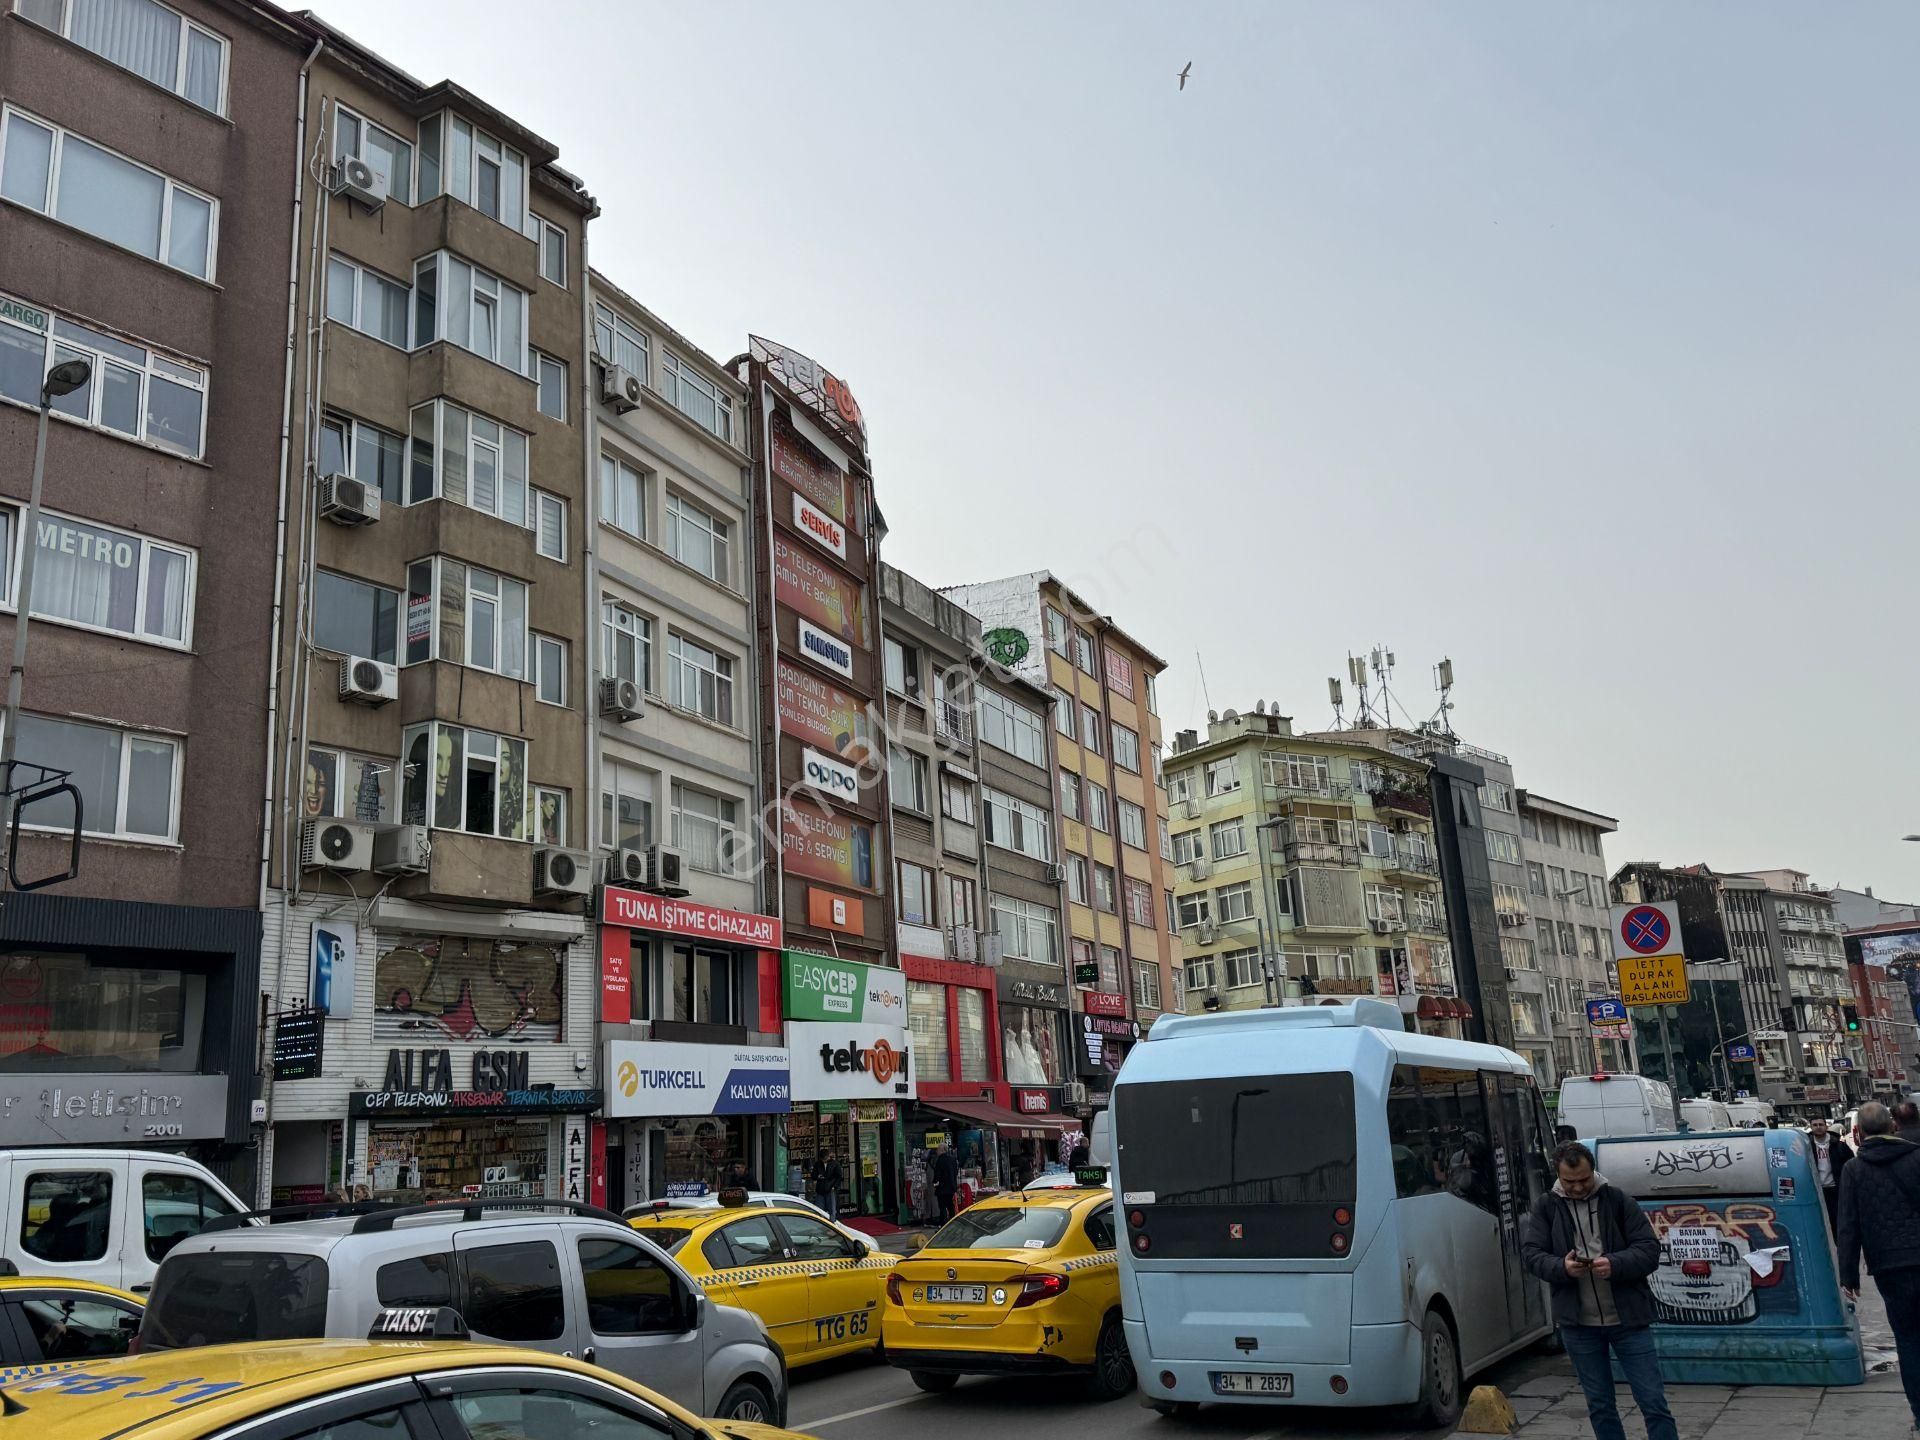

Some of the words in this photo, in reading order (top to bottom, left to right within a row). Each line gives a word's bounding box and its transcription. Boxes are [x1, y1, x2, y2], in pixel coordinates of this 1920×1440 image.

[0, 300, 44, 328] ARGO
[801, 507, 841, 548] SERVİS
[35, 520, 133, 569] METRO
[775, 541, 788, 559] EP
[790, 550, 836, 590] TELEFONU
[800, 578, 812, 597] VE
[804, 630, 849, 669] SAMSUNG
[780, 704, 806, 726] RÜNLER
[807, 761, 856, 792] oppo
[798, 812, 846, 841] TELEFONU
[616, 897, 658, 922] TUNA
[661, 900, 705, 929] İŞİTME
[707, 910, 773, 941] CİHAZLARI
[793, 963, 858, 995] EASYCEP
[1630, 968, 1674, 980] DURAK
[1633, 980, 1674, 991] ALANI
[827, 999, 848, 1009] EXPRESS
[1624, 989, 1686, 1003] BAŞLANGICI
[1093, 1018, 1111, 1033] LOTUS
[382, 1048, 453, 1091] ALFA
[472, 1050, 529, 1091] GSM
[640, 1069, 706, 1089] TURKCELL
[365, 1092, 391, 1107] CEP
[392, 1091, 448, 1107] TELEFONU
[453, 1092, 504, 1107] AKSESUAR
[730, 1084, 767, 1099] KALYON
[769, 1084, 788, 1099] GSM
[1024, 1091, 1047, 1110] hemis
[144, 1123, 183, 1136] 2001
[1672, 1237, 1701, 1246] KİRALIK
[1702, 1238, 1718, 1246] ODA
[1673, 1248, 1688, 1259] 0554
[1689, 1248, 1701, 1259] 120
[1711, 1247, 1720, 1259] 25
[932, 1287, 943, 1299] 34
[949, 1287, 964, 1300] TCY
[972, 1288, 983, 1301] 52
[815, 1316, 845, 1342] TTG
[850, 1311, 868, 1336] 65
[1222, 1375, 1235, 1389] 34
[1245, 1376, 1252, 1390] M
[1260, 1376, 1288, 1391] 2837
